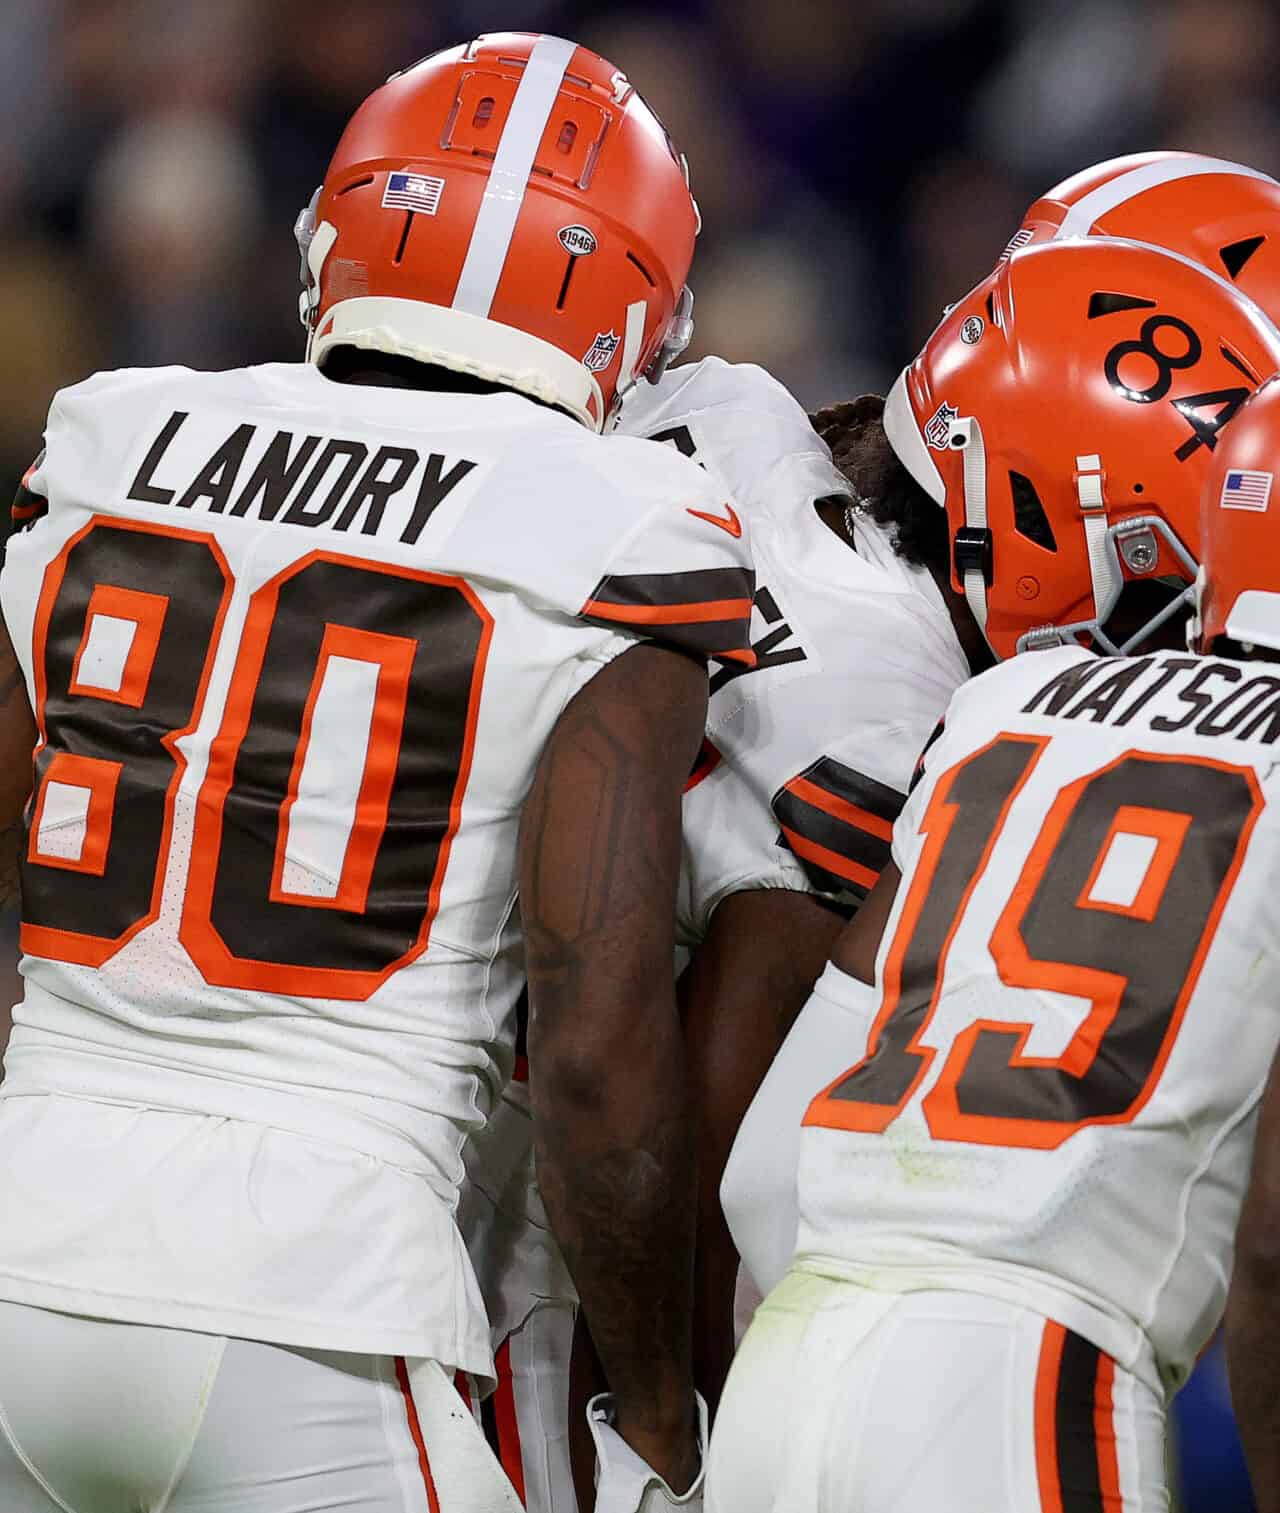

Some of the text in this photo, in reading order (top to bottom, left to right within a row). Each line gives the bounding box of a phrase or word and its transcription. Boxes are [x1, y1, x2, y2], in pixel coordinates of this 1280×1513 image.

[127, 410, 478, 545] LANDRY
[1103, 315, 1251, 463] 84
[19, 513, 496, 1001] 80
[801, 731, 1266, 1151] 19
